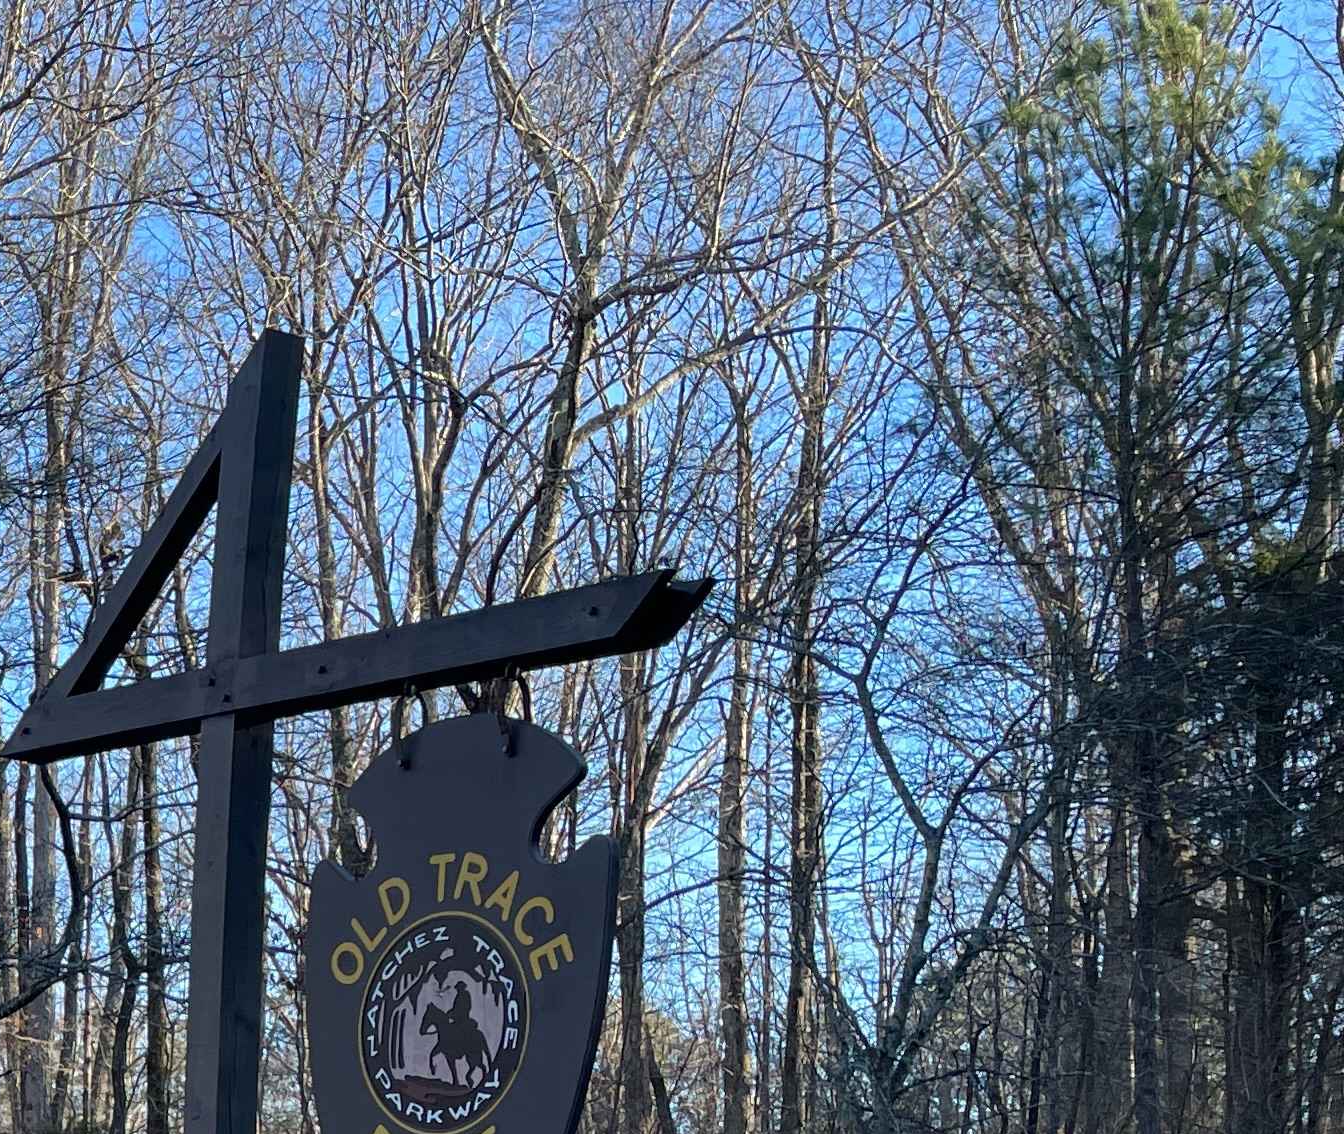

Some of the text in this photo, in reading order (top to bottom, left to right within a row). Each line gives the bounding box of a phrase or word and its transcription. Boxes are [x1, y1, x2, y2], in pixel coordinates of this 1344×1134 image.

[331, 852, 574, 985] OLD TRACE
[366, 926, 519, 1057] NATCHEZ TRACE
[375, 1067, 500, 1124] PARKWAY
